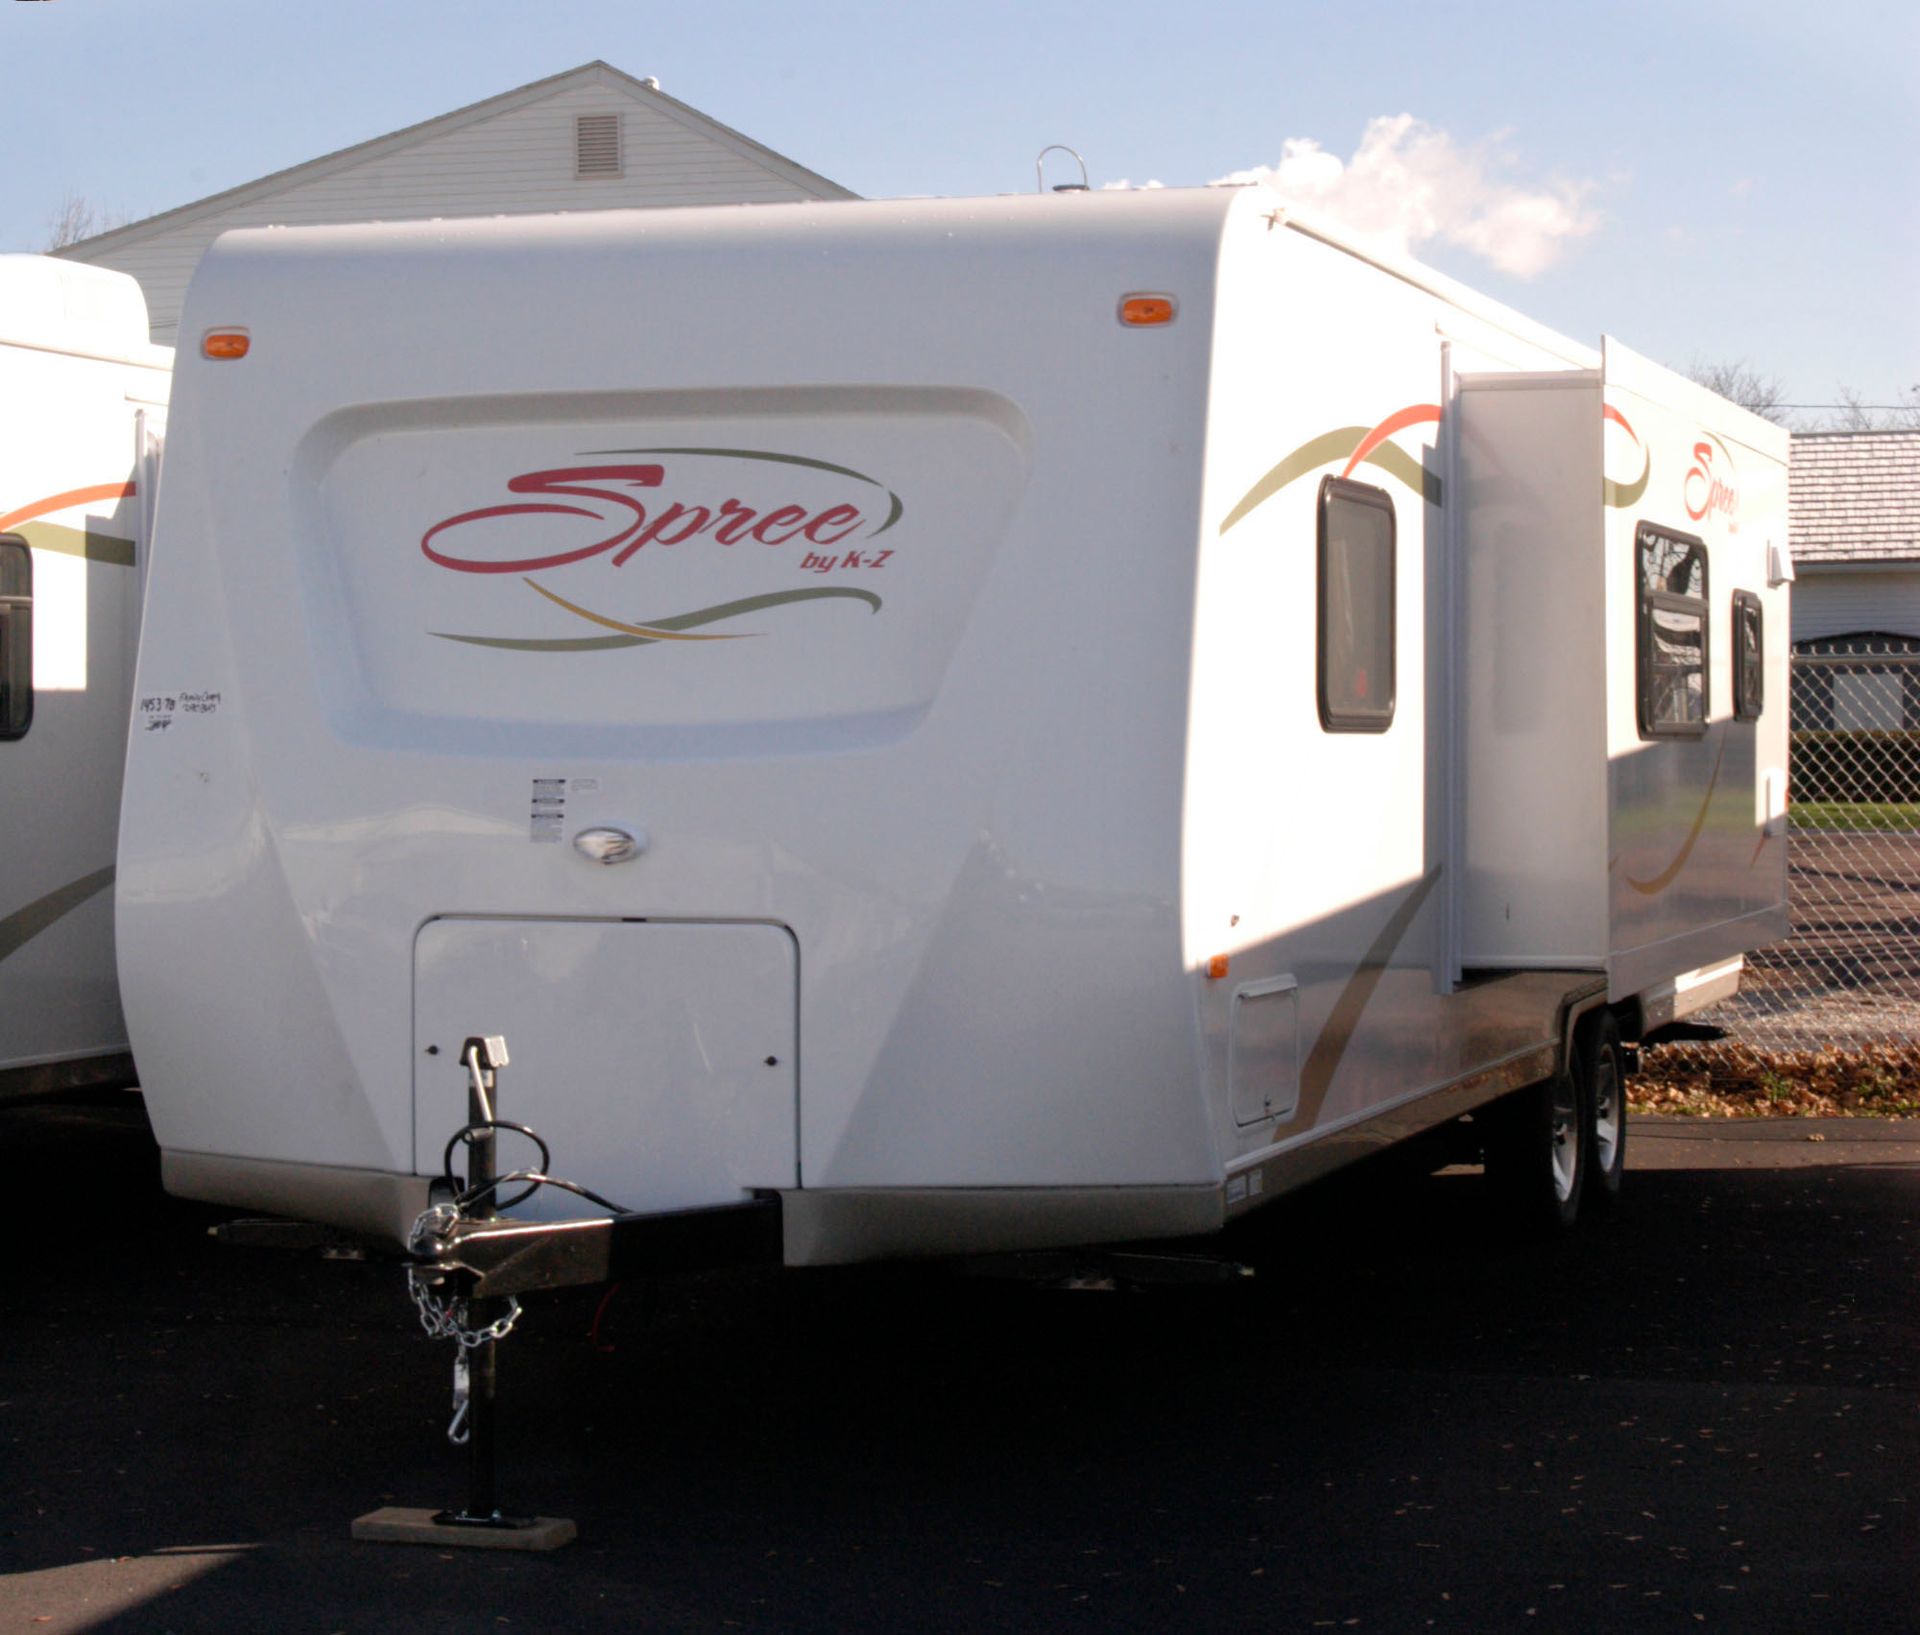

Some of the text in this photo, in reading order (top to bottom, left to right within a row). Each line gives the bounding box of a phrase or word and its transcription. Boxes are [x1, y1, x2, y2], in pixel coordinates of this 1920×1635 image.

[421, 464, 866, 573] Spree
[1682, 442, 1736, 521] Spree
[800, 549, 895, 573] by K-Z
